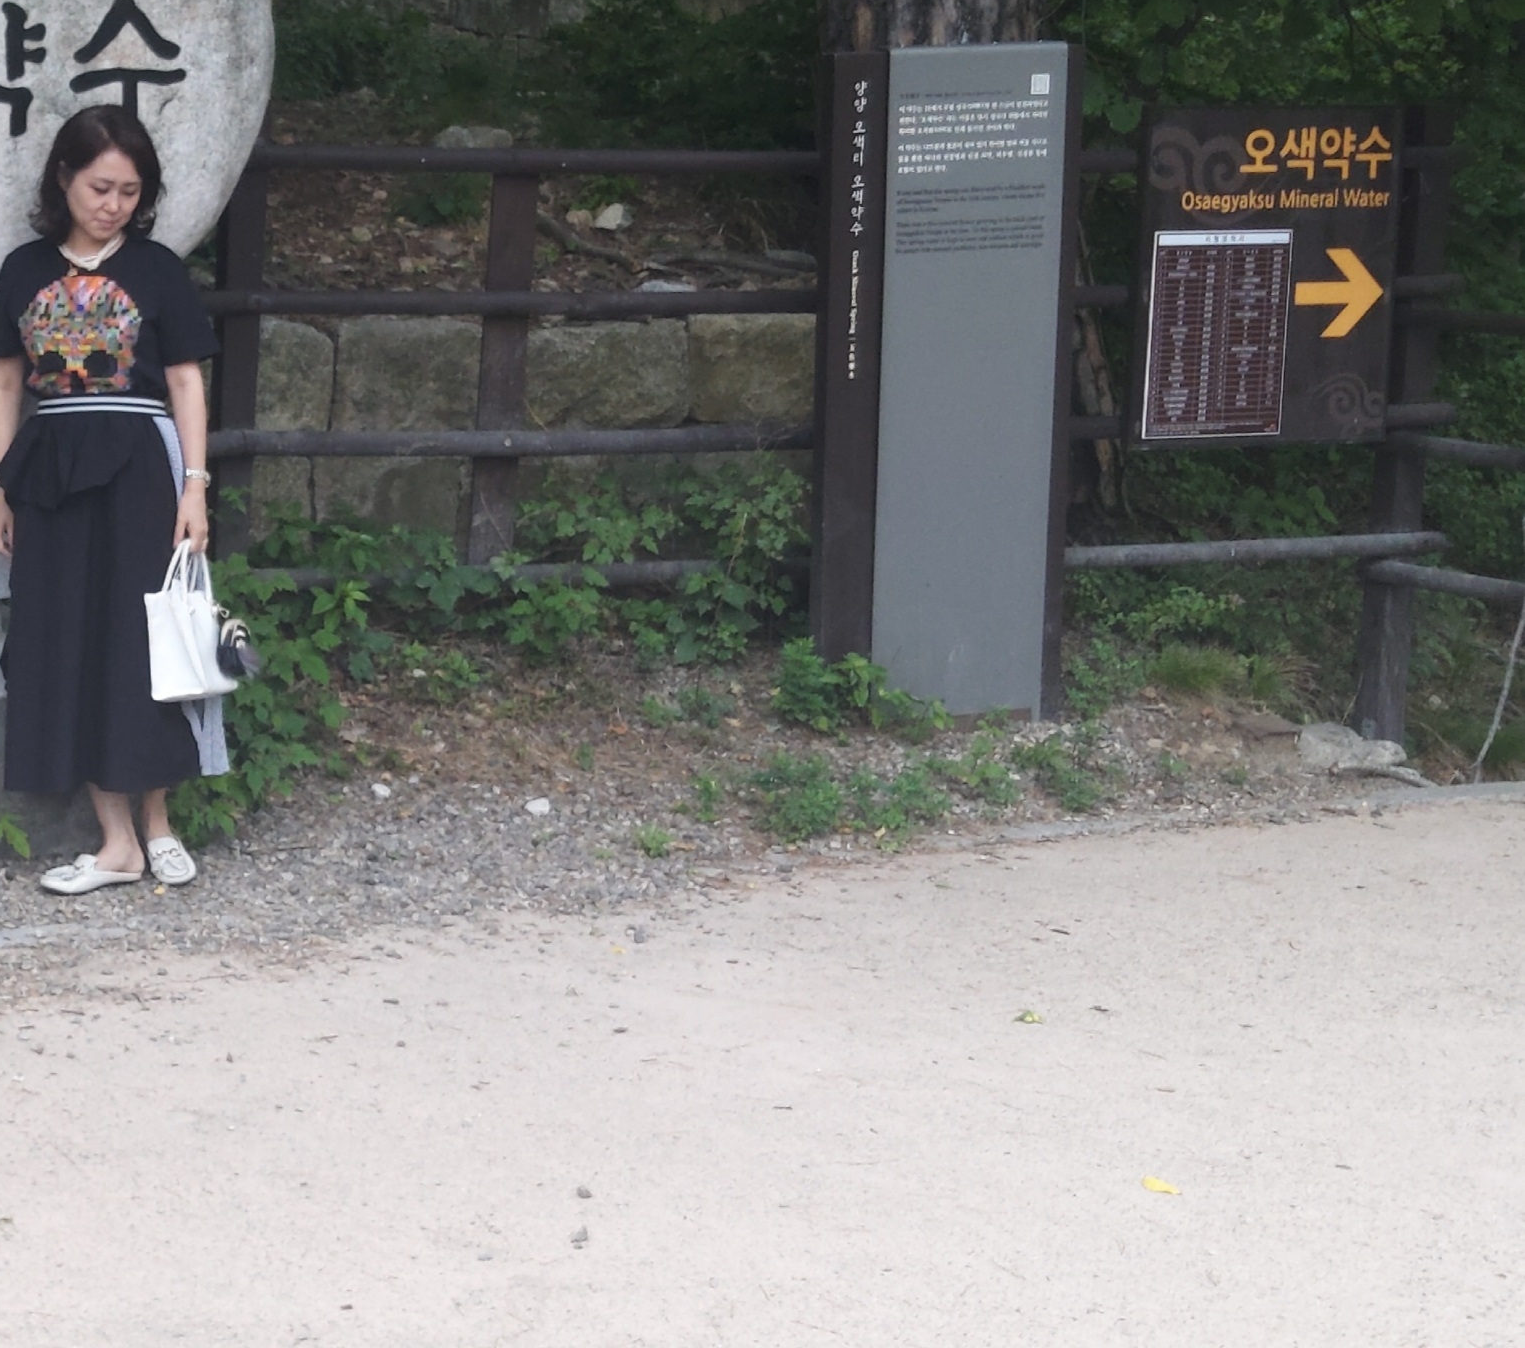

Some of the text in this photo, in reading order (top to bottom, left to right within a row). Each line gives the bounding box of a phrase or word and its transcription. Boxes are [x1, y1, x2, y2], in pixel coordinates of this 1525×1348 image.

[849, 80, 868, 237] 양양 오색리 오색약수
[1239, 126, 1393, 181] 오색약수
[1181, 187, 1391, 213] Osaegyaksu Mineral Water
